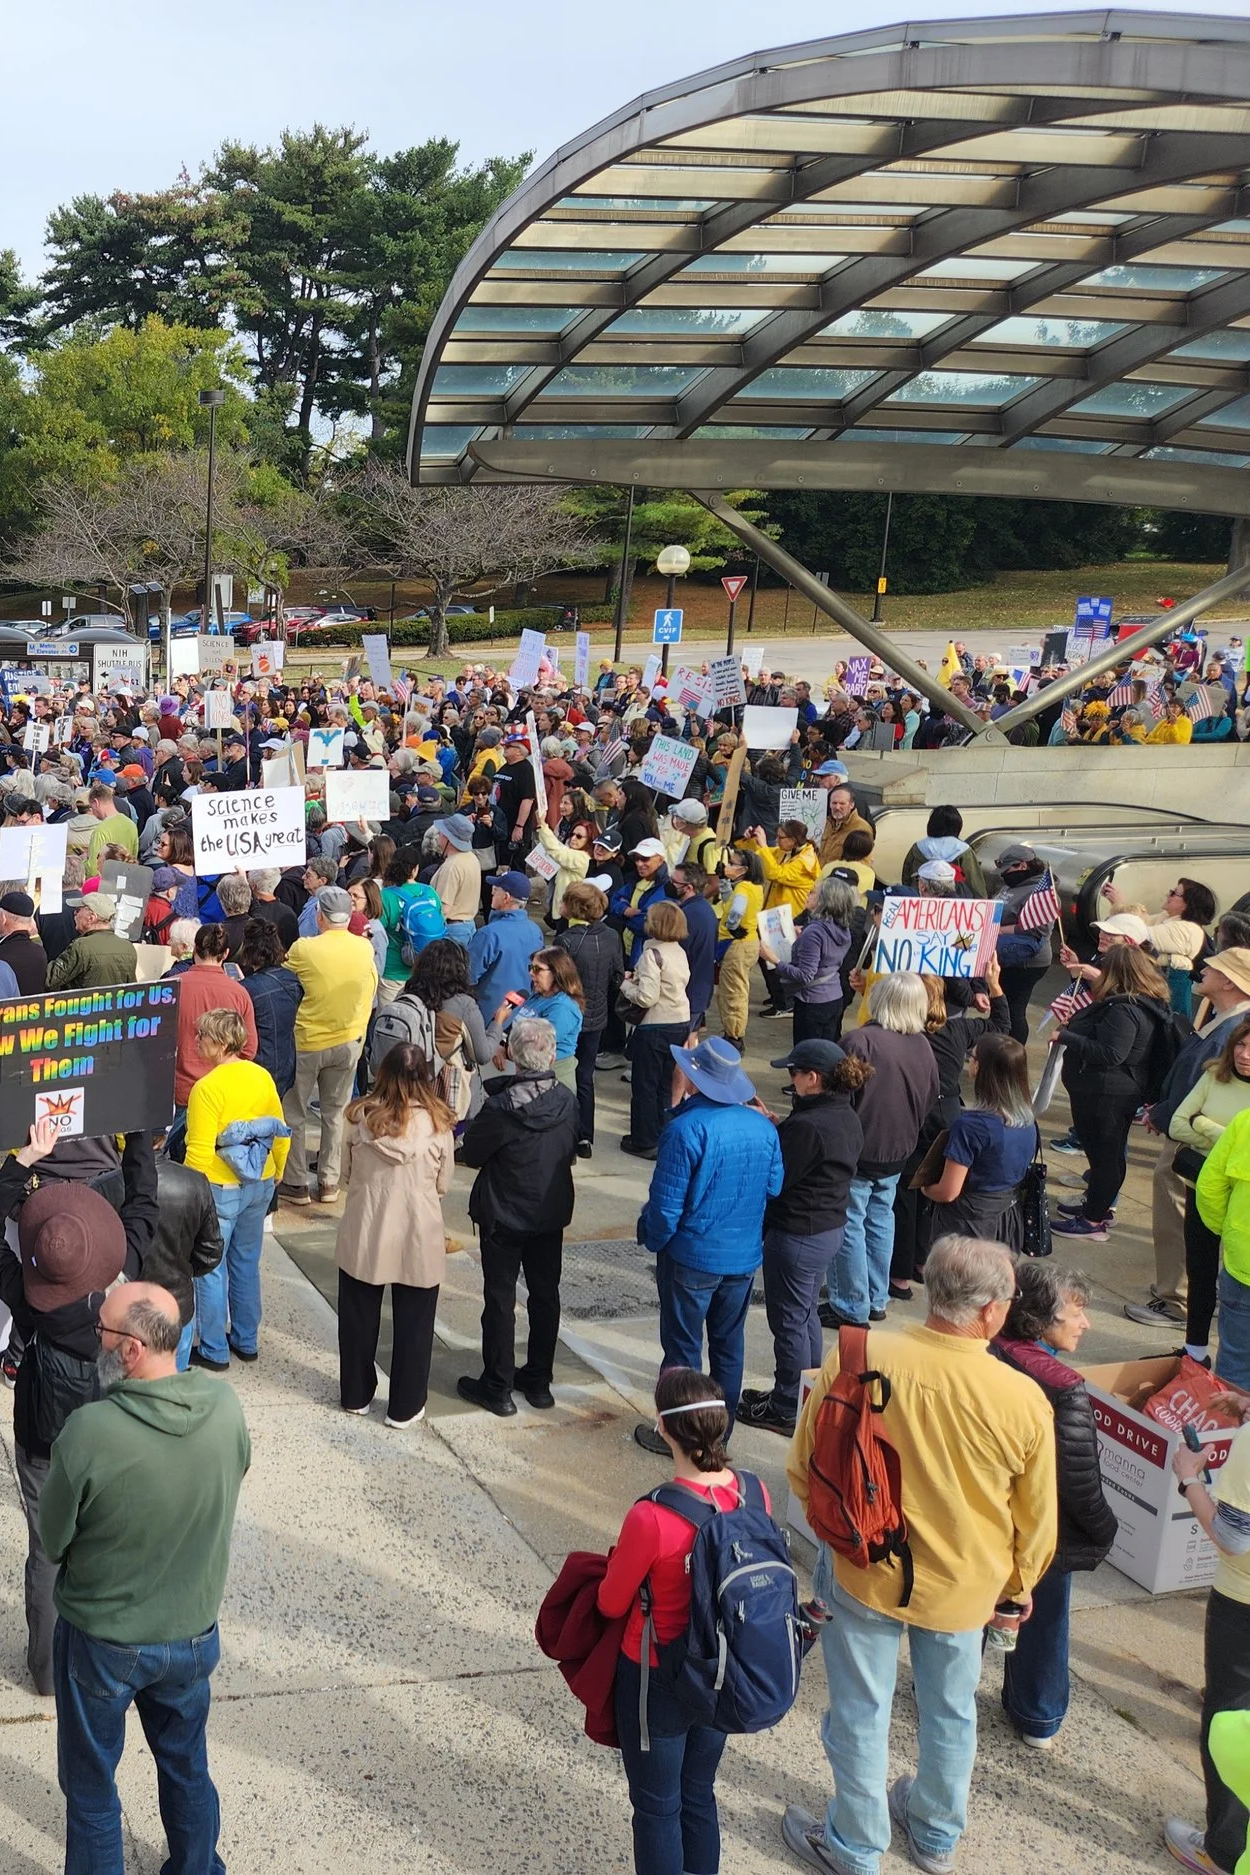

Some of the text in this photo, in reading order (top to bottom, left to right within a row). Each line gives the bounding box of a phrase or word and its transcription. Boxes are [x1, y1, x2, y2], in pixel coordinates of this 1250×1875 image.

[112, 649, 128, 657] NIH
[202, 640, 229, 648] SCIENCE
[849, 657, 868, 674] VAX
[677, 666, 712, 693] RESIS
[853, 671, 868, 684] ME
[845, 683, 867, 696] BABY
[214, 694, 227, 709] NO
[717, 695, 742, 708] NO KINGS
[654, 737, 695, 760] THIS LAND
[653, 751, 690, 772] WAS MADE
[656, 765, 668, 775] FOR
[643, 771, 656, 786] YOU
[662, 781, 676, 793] ME
[781, 789, 818, 800] GIVE ME
[223, 811, 278, 830] makes
[200, 827, 304, 857] the USA great
[882, 899, 986, 931] REAL AMERICANS
[916, 930, 951, 947] SAY
[876, 938, 913, 974] NO
[44, 992, 112, 1018] Fought
[116, 989, 145, 1010] for
[148, 985, 177, 1005] Us,
[19, 1026, 59, 1053] We
[64, 1018, 123, 1048] Fight
[127, 1015, 162, 1039] for
[30, 1055, 94, 1082] Them
[48, 1115, 72, 1127] NO
[1154, 1406, 1183, 1435] COORD
[1093, 1409, 1158, 1457] OD DRIVE
[1104, 1446, 1146, 1480] manna
[1207, 1448, 1227, 1463] OD
[1103, 1458, 1120, 1478] food
[1120, 1470, 1143, 1487] center
